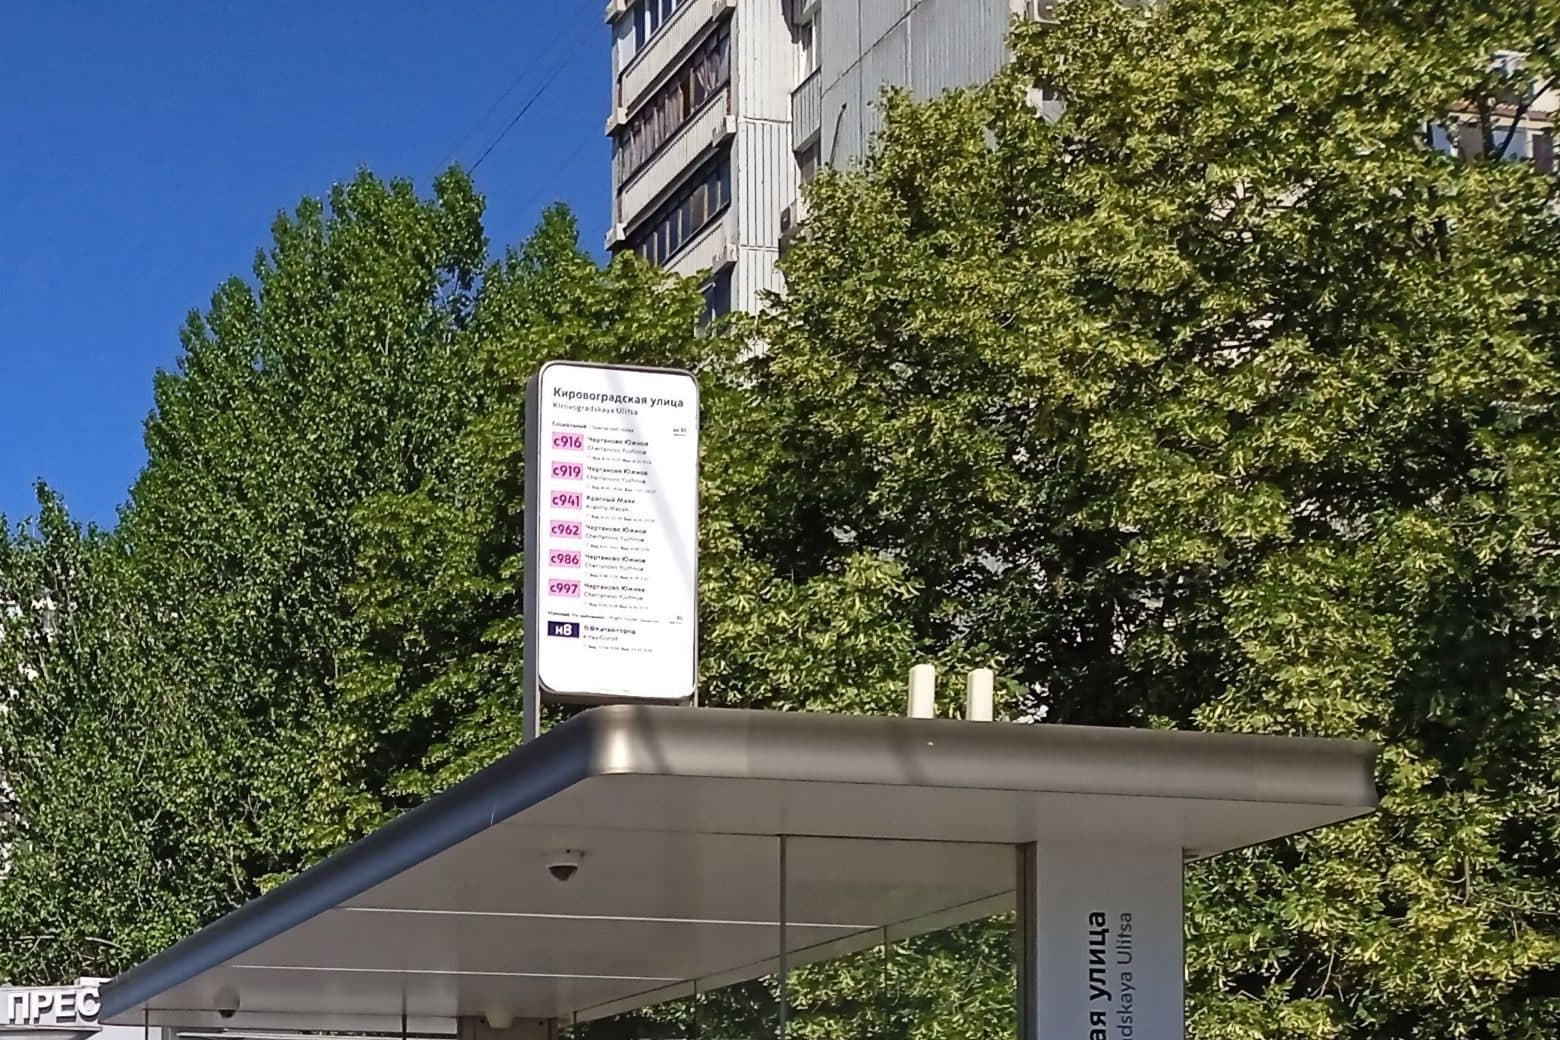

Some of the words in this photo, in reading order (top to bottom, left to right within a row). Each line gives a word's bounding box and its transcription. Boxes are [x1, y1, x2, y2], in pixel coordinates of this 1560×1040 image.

[553, 386, 648, 406] Кировоградская
[650, 394, 684, 409] улица
[1088, 911, 1112, 1002] улица
[1117, 911, 1132, 965] Ulitsa
[8, 987, 100, 1023] ПРЕС
